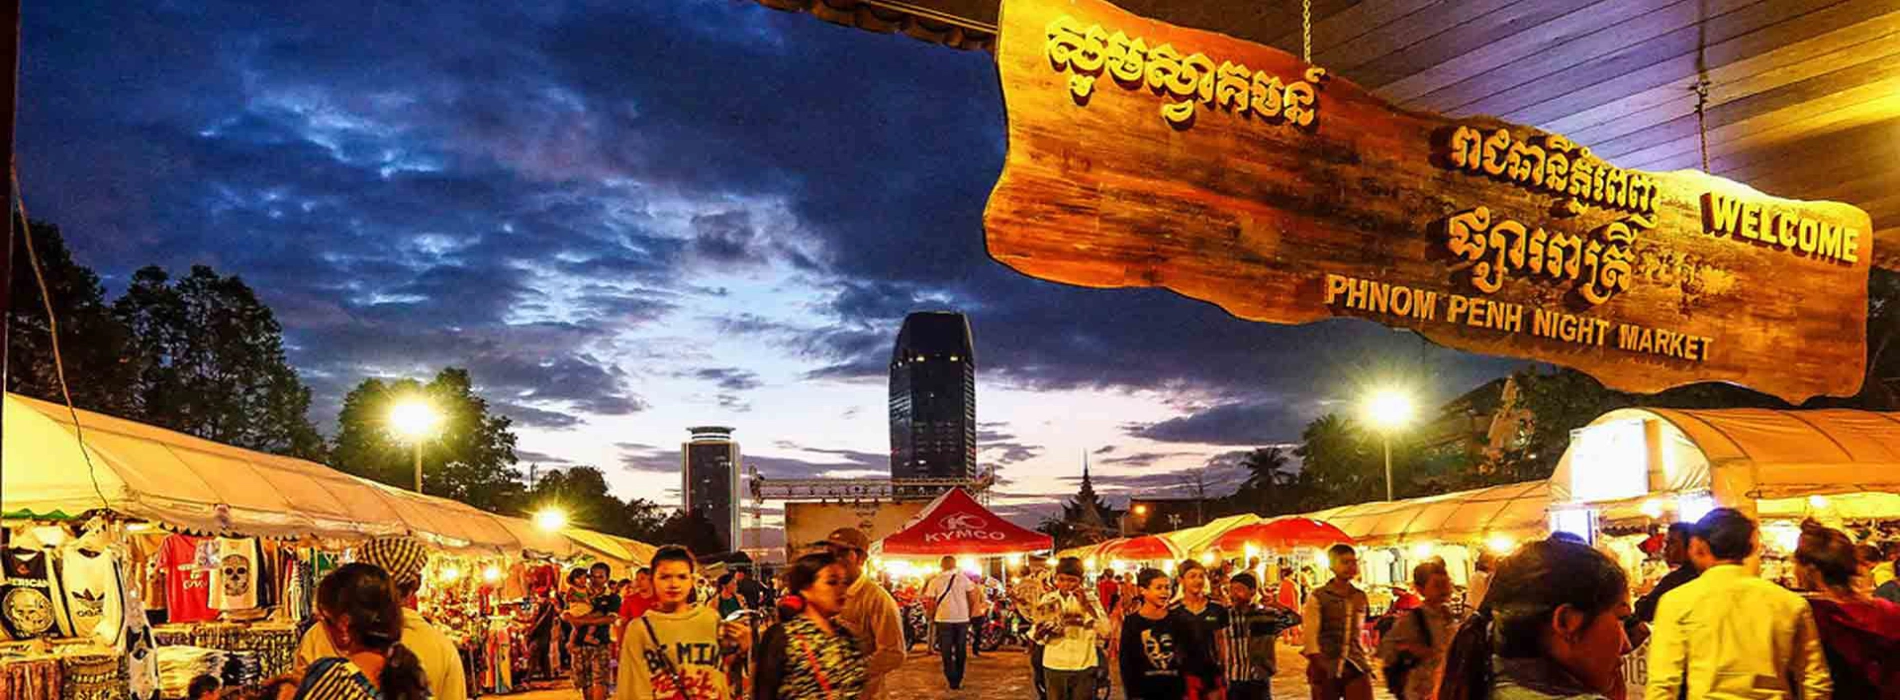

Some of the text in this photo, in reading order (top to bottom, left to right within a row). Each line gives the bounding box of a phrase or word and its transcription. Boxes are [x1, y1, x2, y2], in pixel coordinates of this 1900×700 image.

[1708, 191, 1860, 263] WELCOME
[1324, 273, 1714, 362] PHNOM PENH NIGHT MARKET
[924, 530, 1006, 543] KYMCO
